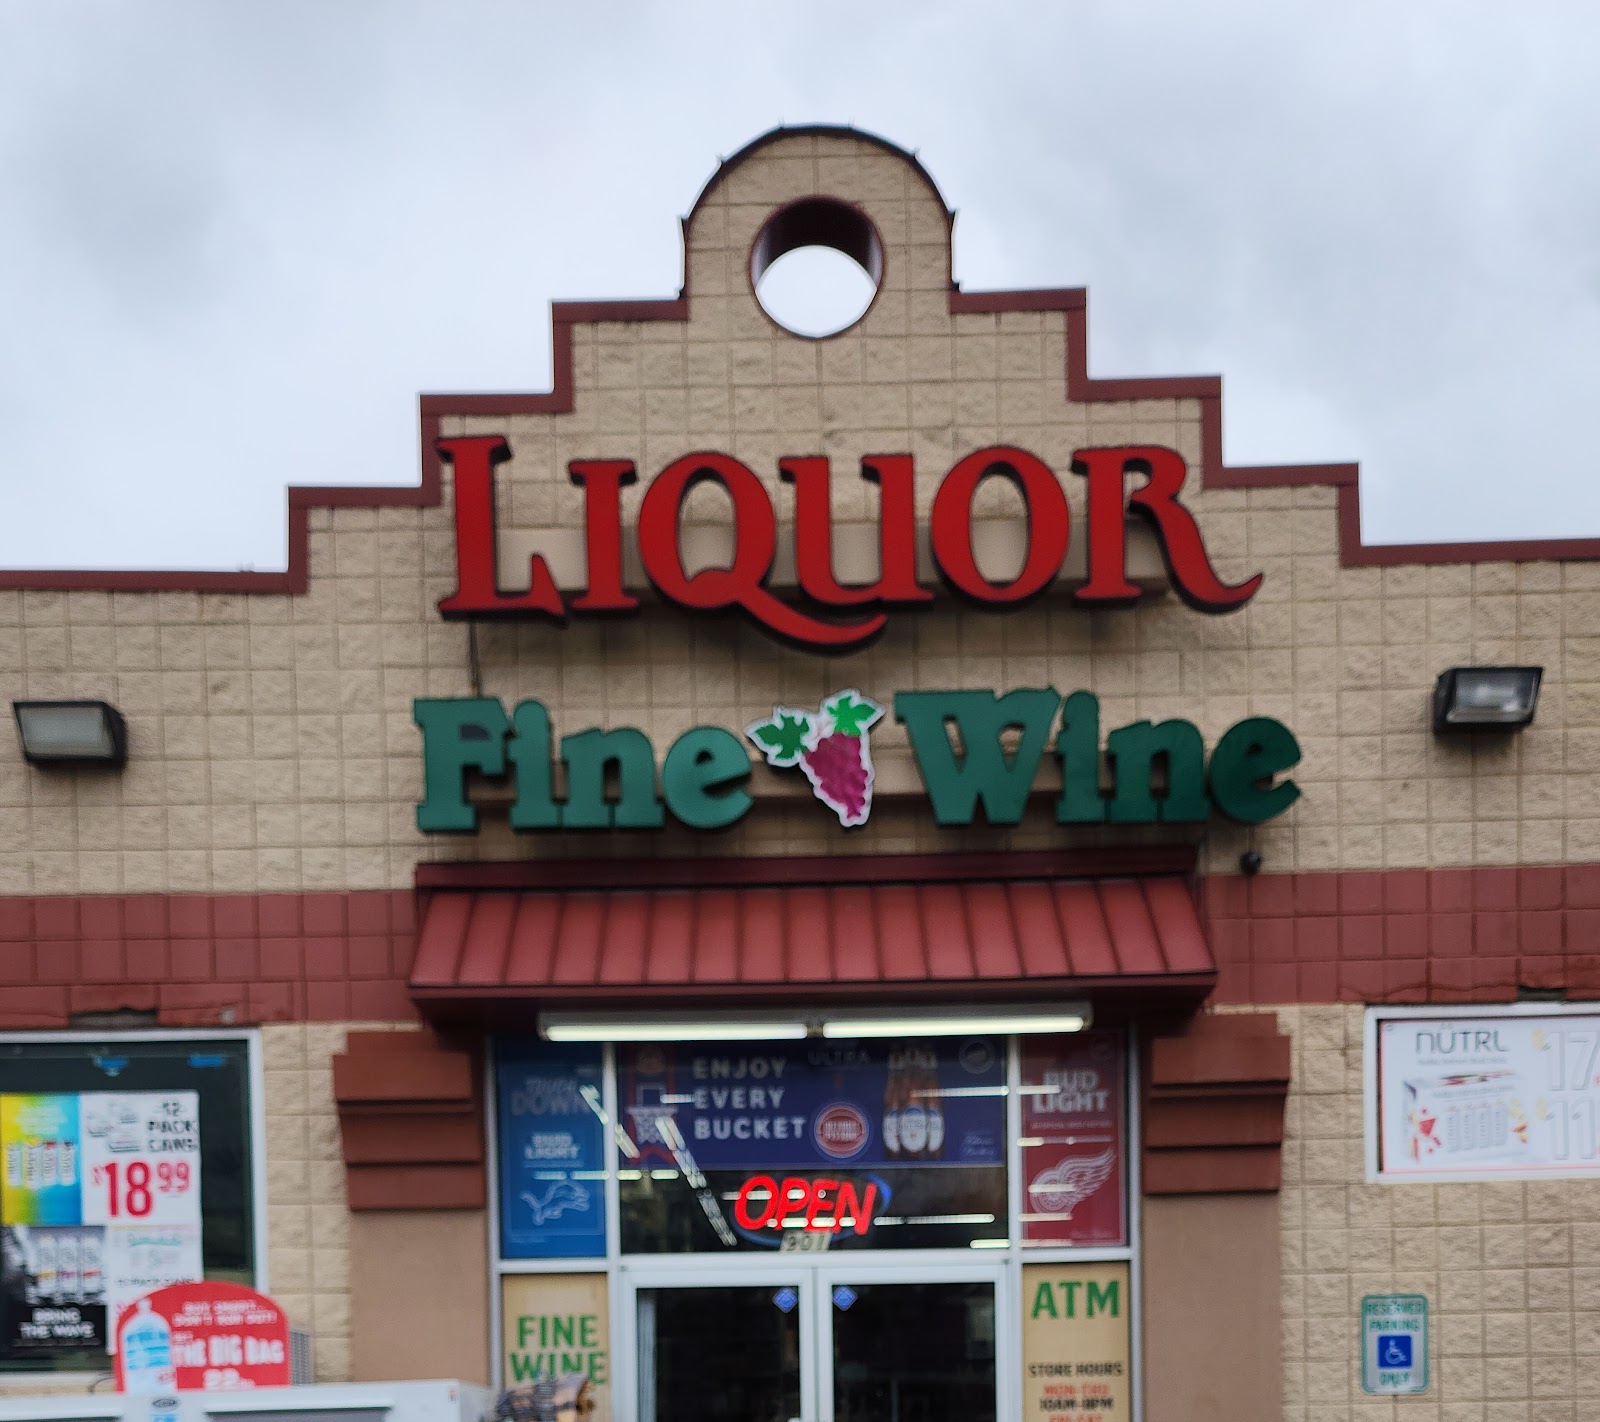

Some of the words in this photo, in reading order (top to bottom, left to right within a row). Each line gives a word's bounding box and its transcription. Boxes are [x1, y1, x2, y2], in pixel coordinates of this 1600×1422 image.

[436, 434, 1263, 653] LIQUOR
[413, 696, 754, 834] Fine
[893, 685, 1303, 825] Wine
[692, 1055, 788, 1080] ENJOY
[1044, 1070, 1100, 1092] BUD
[692, 1085, 787, 1110] EVERY
[1032, 1090, 1111, 1114] LIGHT
[693, 1115, 807, 1140] BUCKET
[734, 1173, 878, 1236] OPEN
[1031, 1279, 1121, 1320] ATM
[516, 1314, 598, 1349] FINE
[208, 1334, 243, 1367] BIG
[244, 1336, 285, 1366] BAG
[510, 1352, 608, 1385] WINE
[1028, 1361, 1073, 1378] STORE
[1075, 1360, 1123, 1377] HOURS
